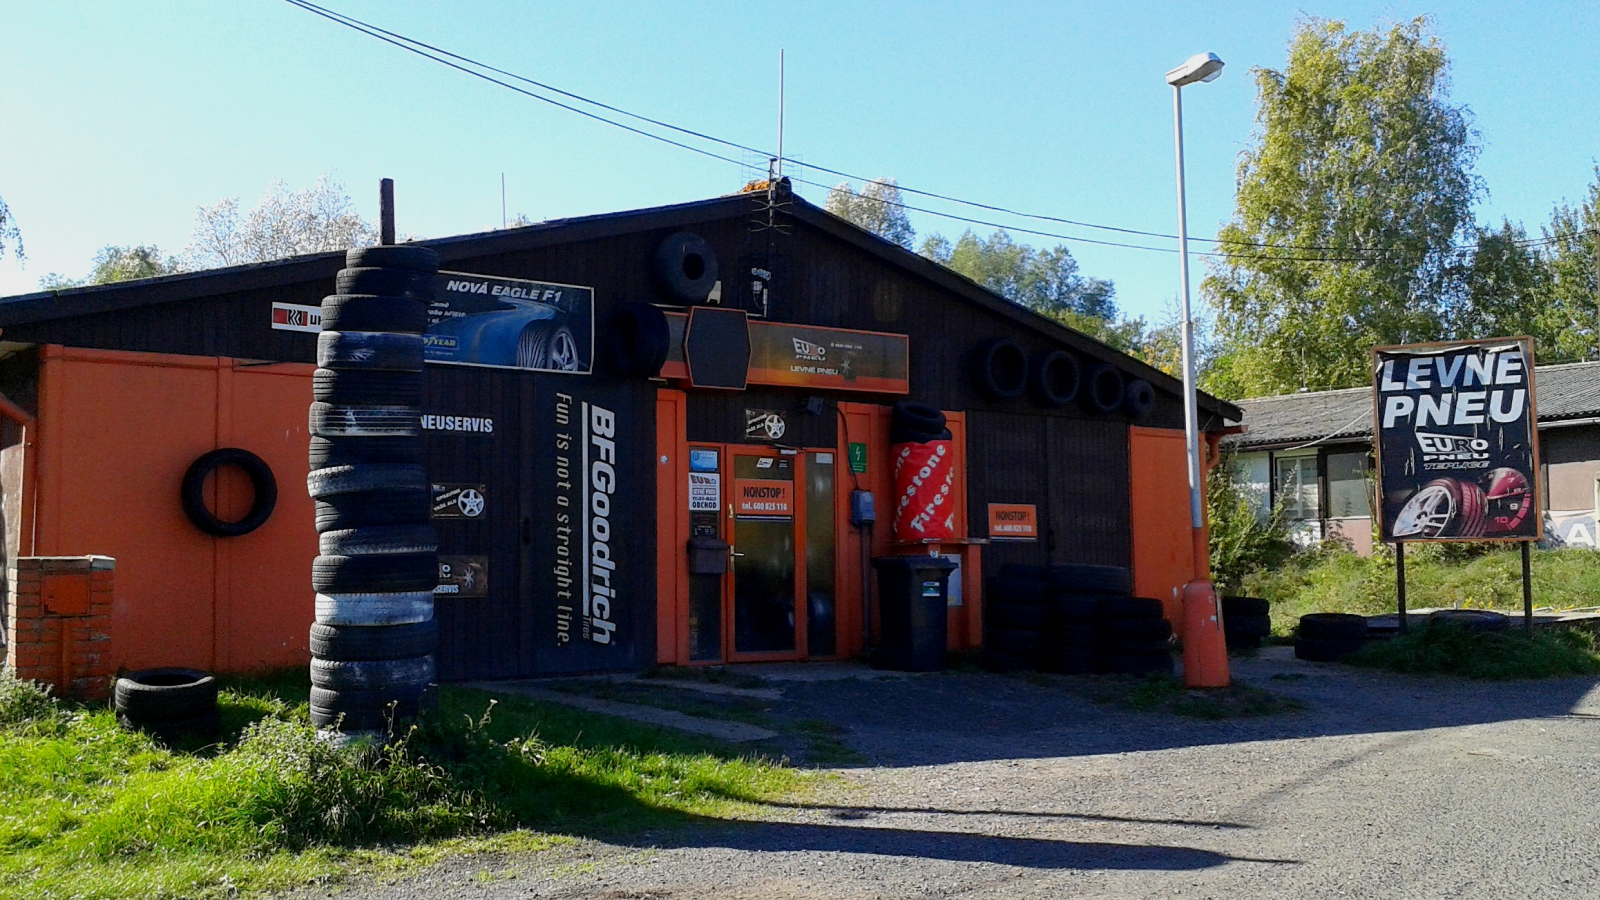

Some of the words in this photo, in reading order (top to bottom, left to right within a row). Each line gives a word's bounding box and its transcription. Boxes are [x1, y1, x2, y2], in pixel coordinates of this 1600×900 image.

[446, 280, 489, 295] NOVÁ
[491, 285, 540, 300] EAGLE
[542, 290, 563, 303] F1
[817, 367, 838, 375] PNEU
[556, 392, 573, 425] Fun
[1382, 389, 1526, 429] PNEU
[556, 432, 573, 450] is
[1414, 432, 1489, 454] EURO
[1423, 453, 1489, 461] PNEU
[1423, 461, 1490, 470] TEPLICE
[556, 456, 573, 490] not
[556, 497, 570, 507] a
[692, 501, 717, 509] OBCHOD
[741, 501, 753, 510] tel.
[776, 503, 788, 511] 110
[591, 404, 617, 645] BFGoodrich
[553, 512, 573, 599] straight
